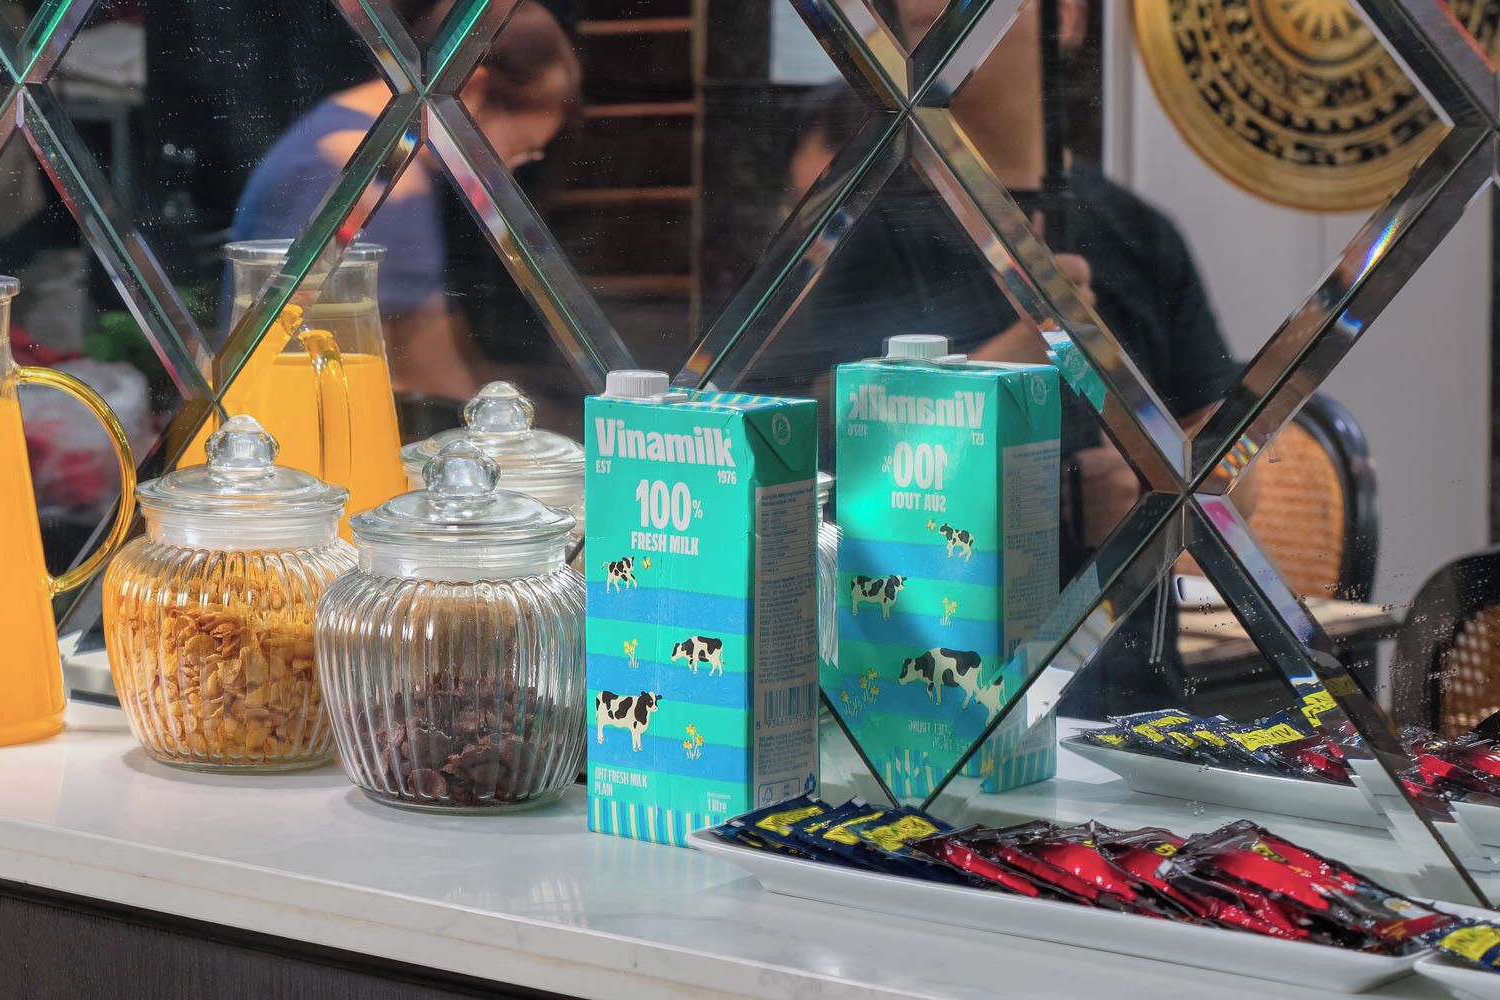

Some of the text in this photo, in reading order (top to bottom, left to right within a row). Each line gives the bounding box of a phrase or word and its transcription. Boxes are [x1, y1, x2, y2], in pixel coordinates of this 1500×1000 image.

[595, 417, 736, 467] Vinamilk
[595, 459, 612, 474] EST
[717, 470, 737, 485] 1976
[635, 479, 703, 532] 100%
[631, 531, 699, 556] FRESH MILK
[594, 767, 648, 789] UHT FRESH MILK
[594, 781, 613, 797] PLAIN
